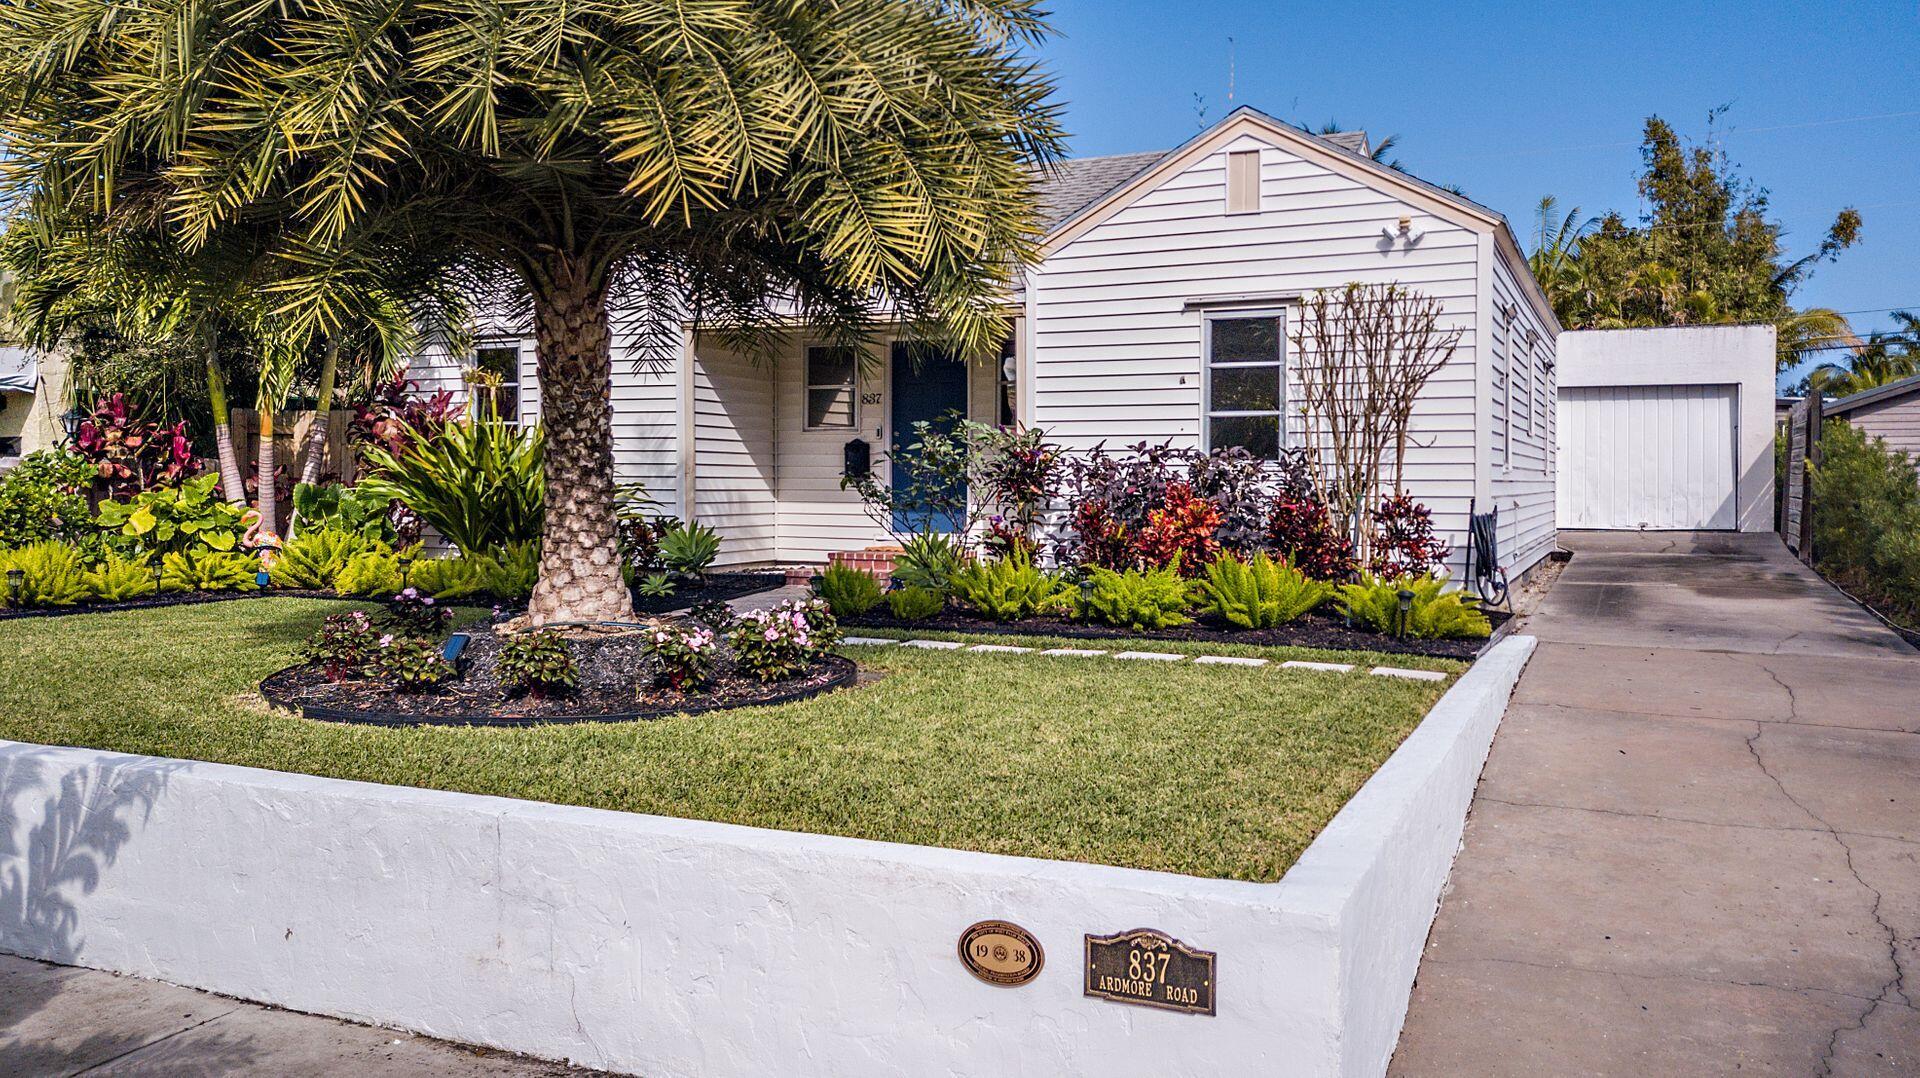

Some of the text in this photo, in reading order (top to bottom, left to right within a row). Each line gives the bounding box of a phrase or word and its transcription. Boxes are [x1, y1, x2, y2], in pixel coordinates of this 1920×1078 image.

[862, 393, 882, 404] 837
[976, 944, 1026, 963] 19 38
[1129, 949, 1171, 984] 837
[1099, 975, 1198, 1004] ARDMORE ROAD
